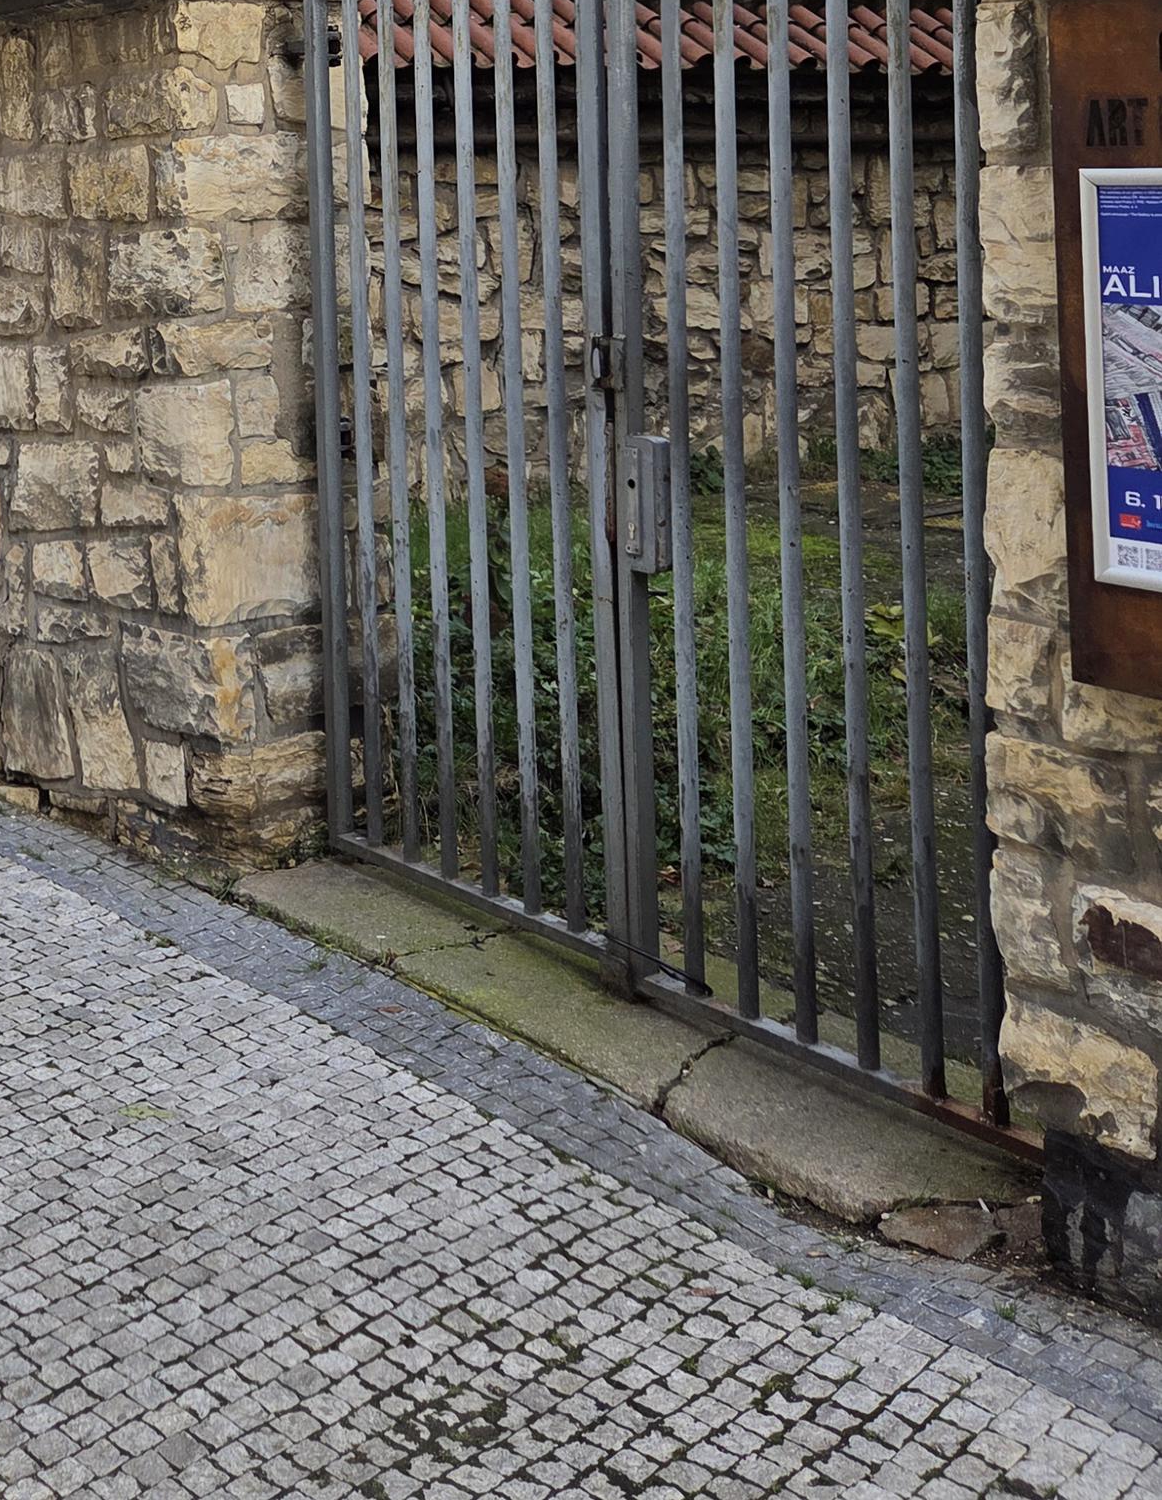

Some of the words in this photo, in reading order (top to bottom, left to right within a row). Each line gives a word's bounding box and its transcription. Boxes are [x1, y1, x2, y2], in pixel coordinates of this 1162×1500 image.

[1086, 98, 1148, 147] ART
[1102, 265, 1135, 274] MAAZ
[1103, 273, 1161, 298] ALI
[1125, 490, 1146, 508] 6.
